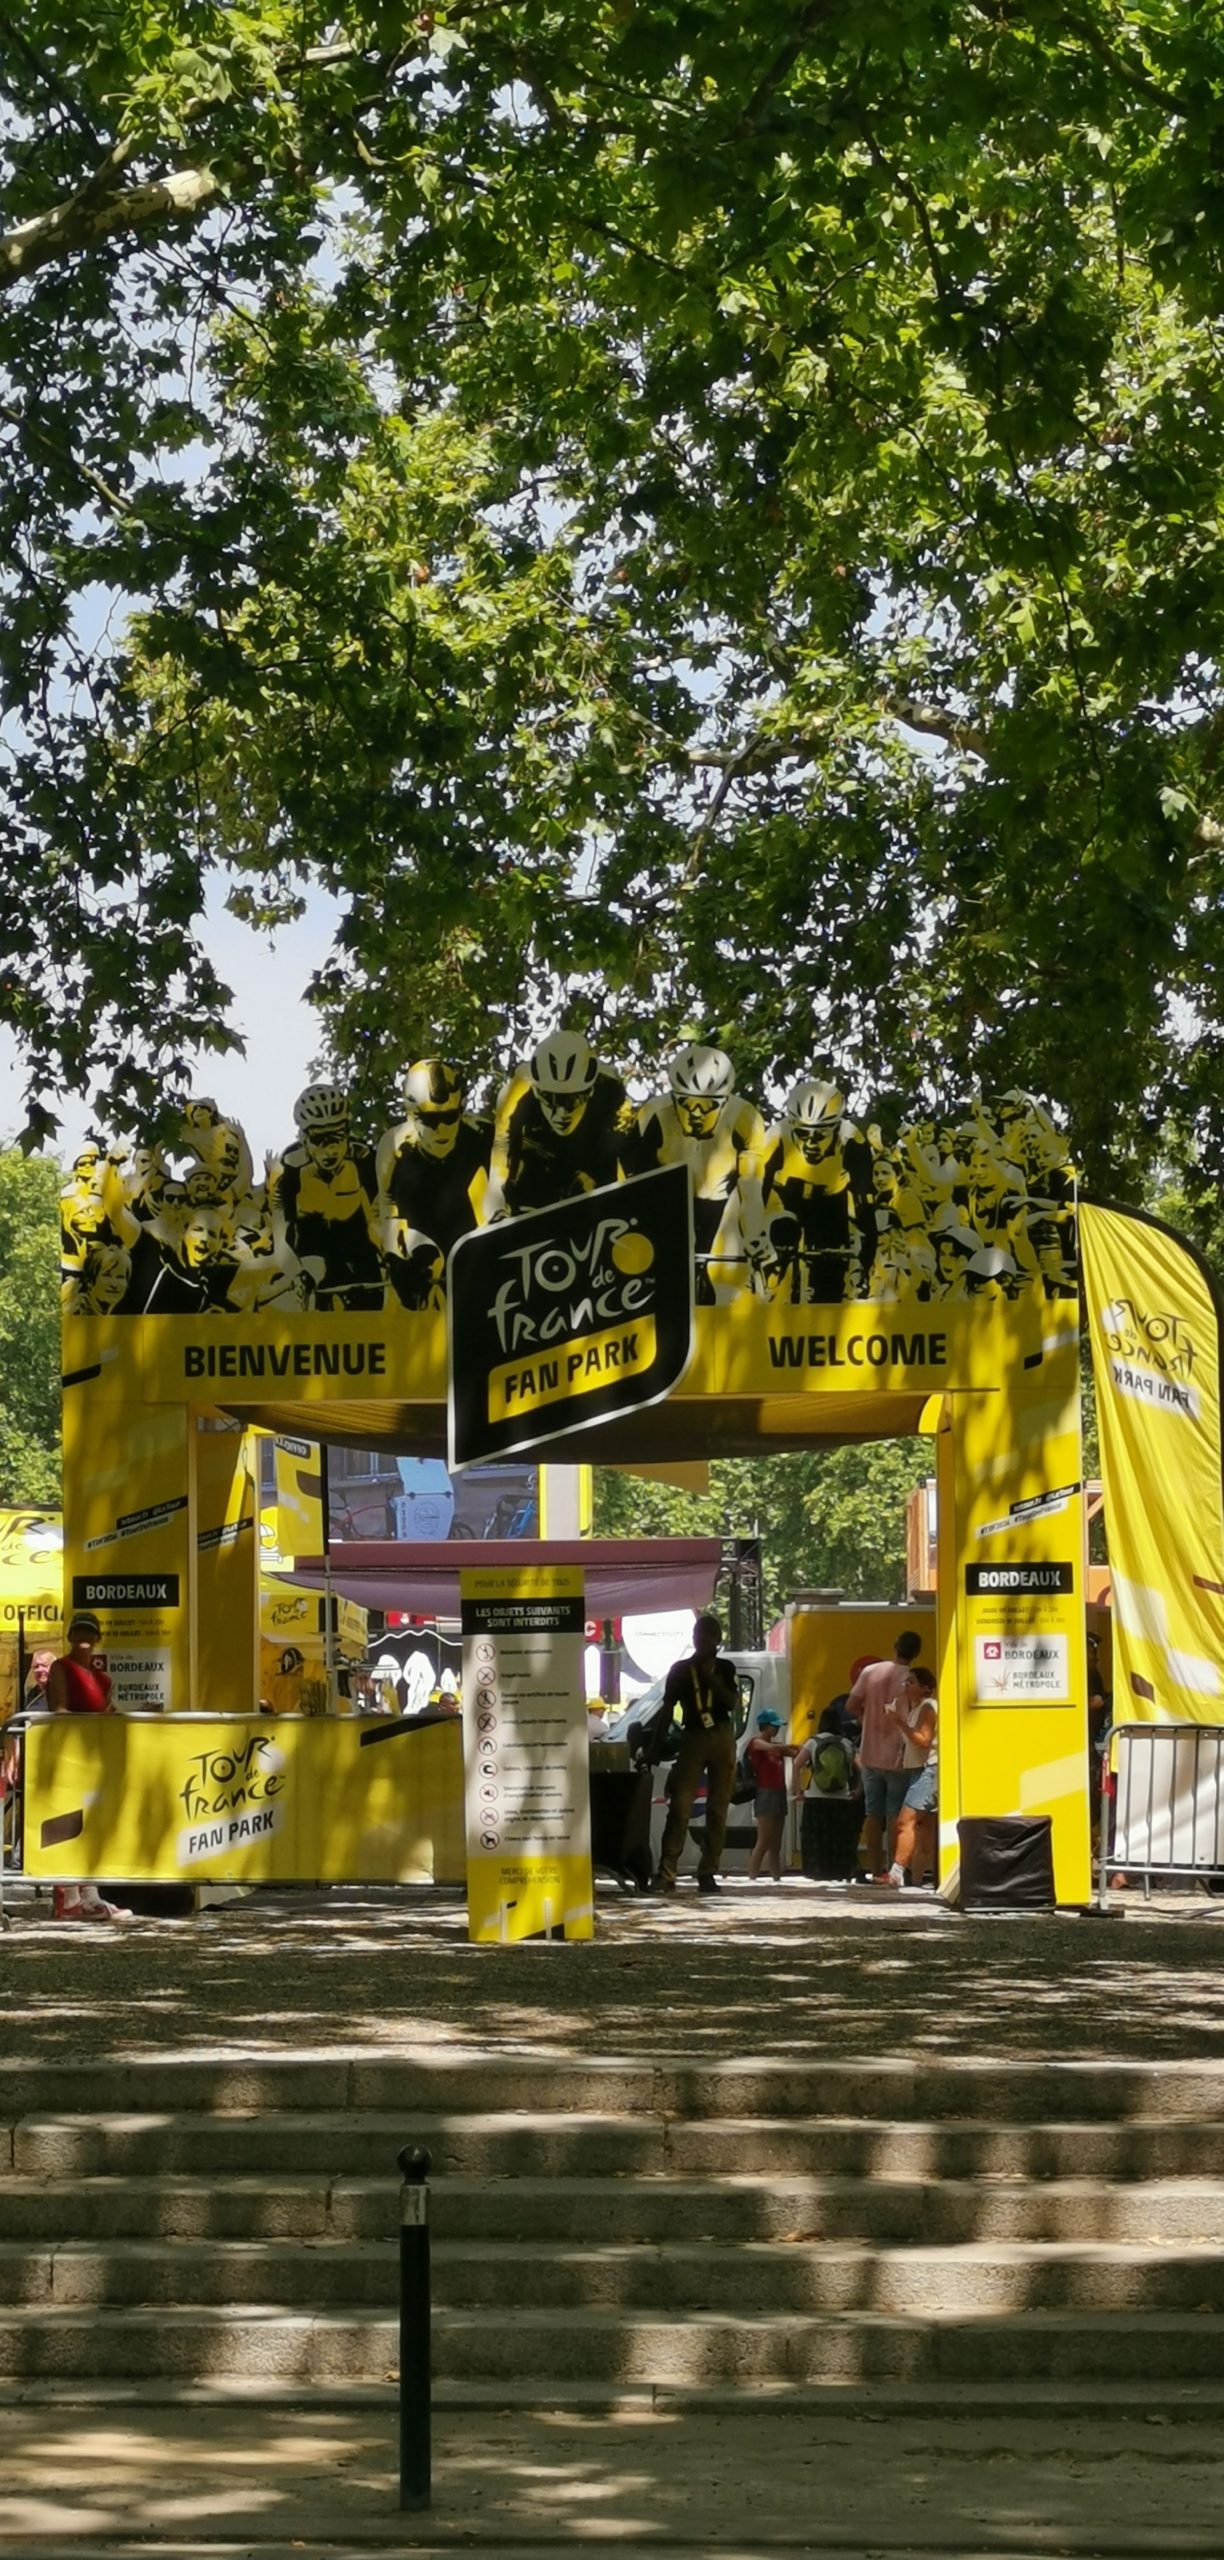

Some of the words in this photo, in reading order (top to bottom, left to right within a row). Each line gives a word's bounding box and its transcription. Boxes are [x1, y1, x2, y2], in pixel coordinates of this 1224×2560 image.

[592, 1268, 616, 1288] de
[768, 1333, 947, 1368] WELCOME
[184, 1343, 386, 1378] BIENVENUE
[504, 1360, 558, 1404] FAN
[567, 1333, 638, 1383] PARK
[978, 1571, 1061, 1587] BORDEAUX
[86, 1583, 167, 1600] BORDEAUX
[3, 1604, 64, 1621] OFFICI
[475, 1607, 491, 1617] LES
[493, 1606, 524, 1617] OBJETS
[526, 1606, 571, 1616] SUIVANTS
[487, 1617, 511, 1628] SONT
[513, 1617, 560, 1627] INTERDITS
[1004, 1650, 1059, 1660] BORDEAUX
[110, 1662, 165, 1672] BORDEAUX
[1012, 1670, 1055, 1679] BORDEAUX
[118, 1683, 160, 1692] BORDEAUX
[1012, 1679, 1061, 1688] MÉTROPOLE
[118, 1692, 164, 1701] MÉTROPOLE
[245, 1769, 259, 1781] de
[188, 1827, 223, 1854] FAN
[228, 1810, 274, 1842] PARK
